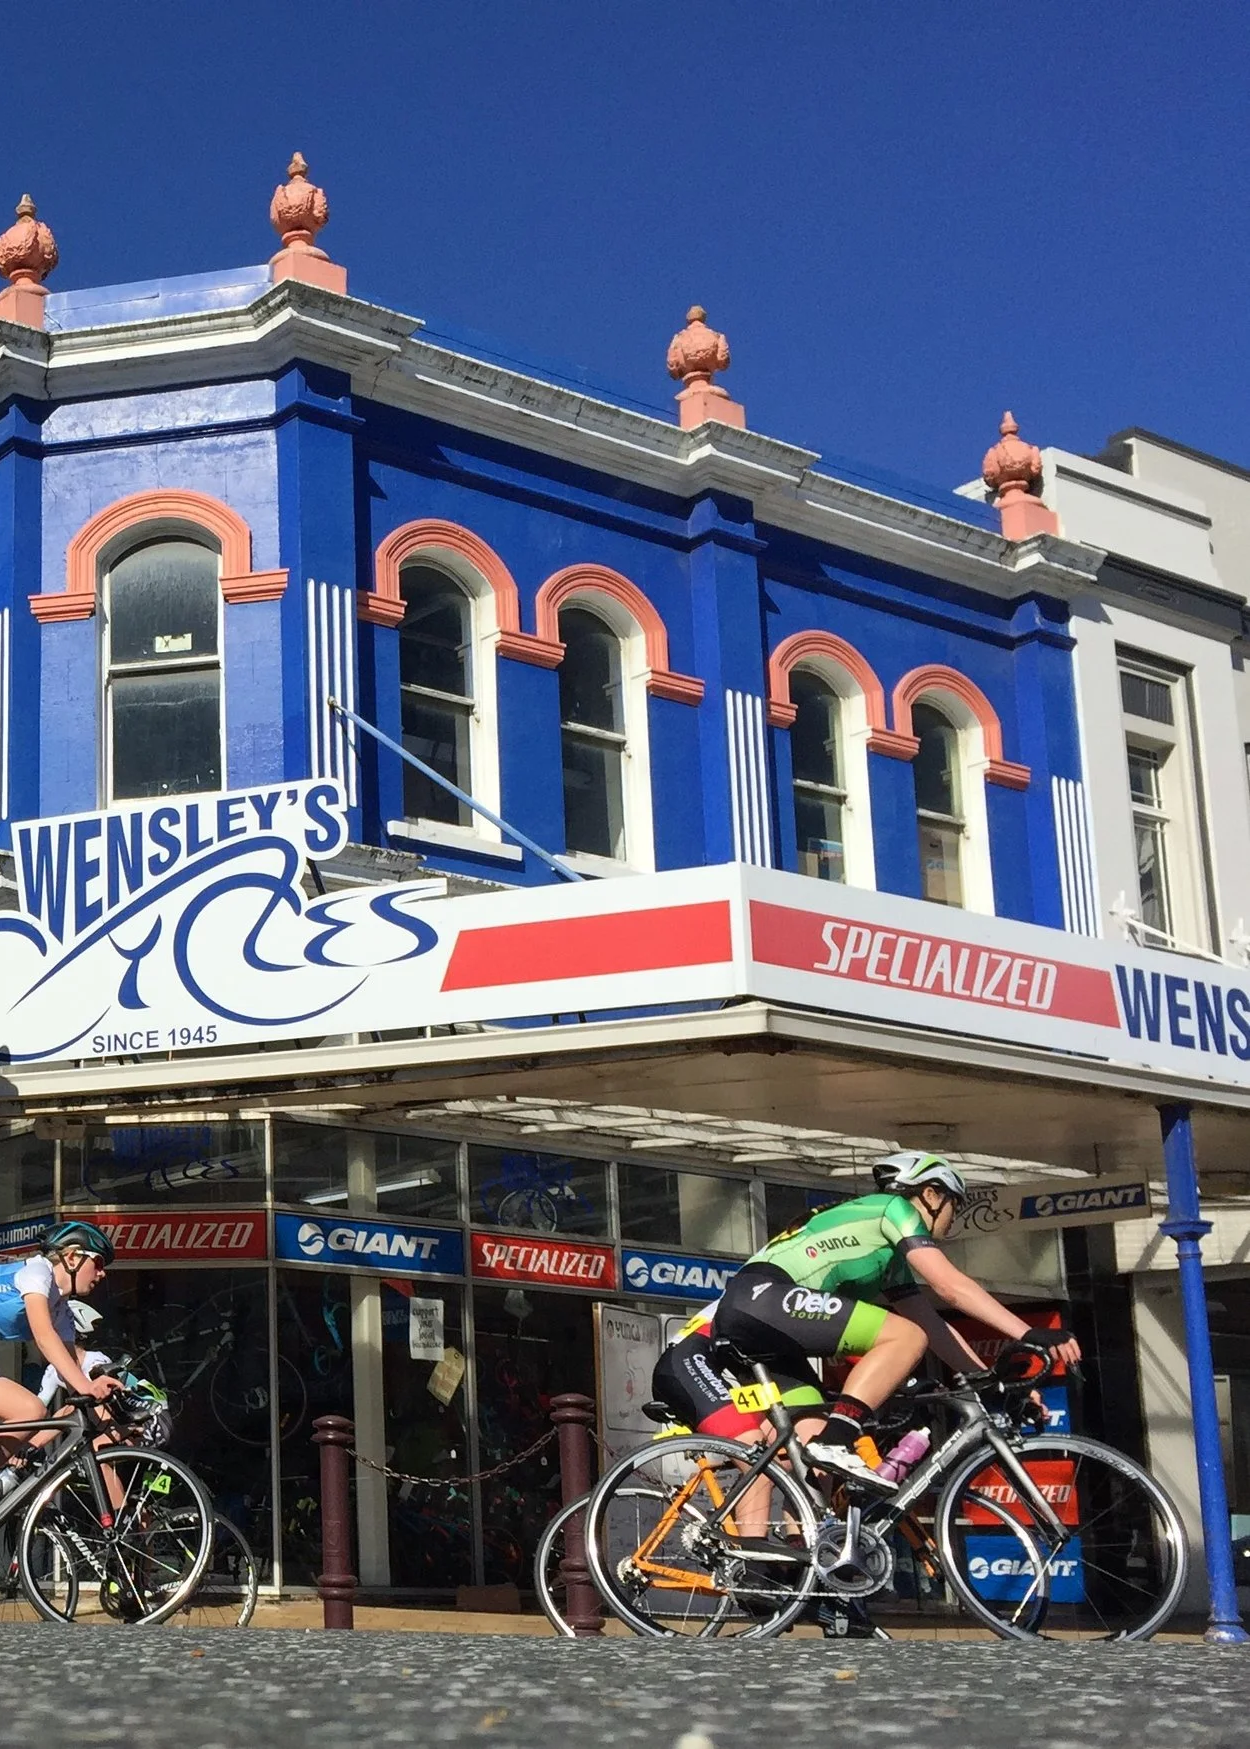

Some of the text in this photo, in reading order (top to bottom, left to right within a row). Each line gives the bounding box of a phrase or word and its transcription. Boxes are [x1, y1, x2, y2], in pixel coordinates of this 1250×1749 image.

[18, 783, 342, 944] WENSLEY'S
[813, 920, 1058, 1010] SPECIALIZED
[1115, 964, 1250, 1061] WENS
[91, 1024, 218, 1054] SINCE 1945
[1056, 1187, 1142, 1212] GIANT
[327, 1227, 440, 1260] GIANT
[477, 1242, 607, 1280] SPECIALIZED
[789, 1310, 832, 1321] SOUTH
[683, 1357, 719, 1403] TRACK CYCLING
[692, 1353, 733, 1401] Canterbury
[736, 1389, 761, 1409] 41
